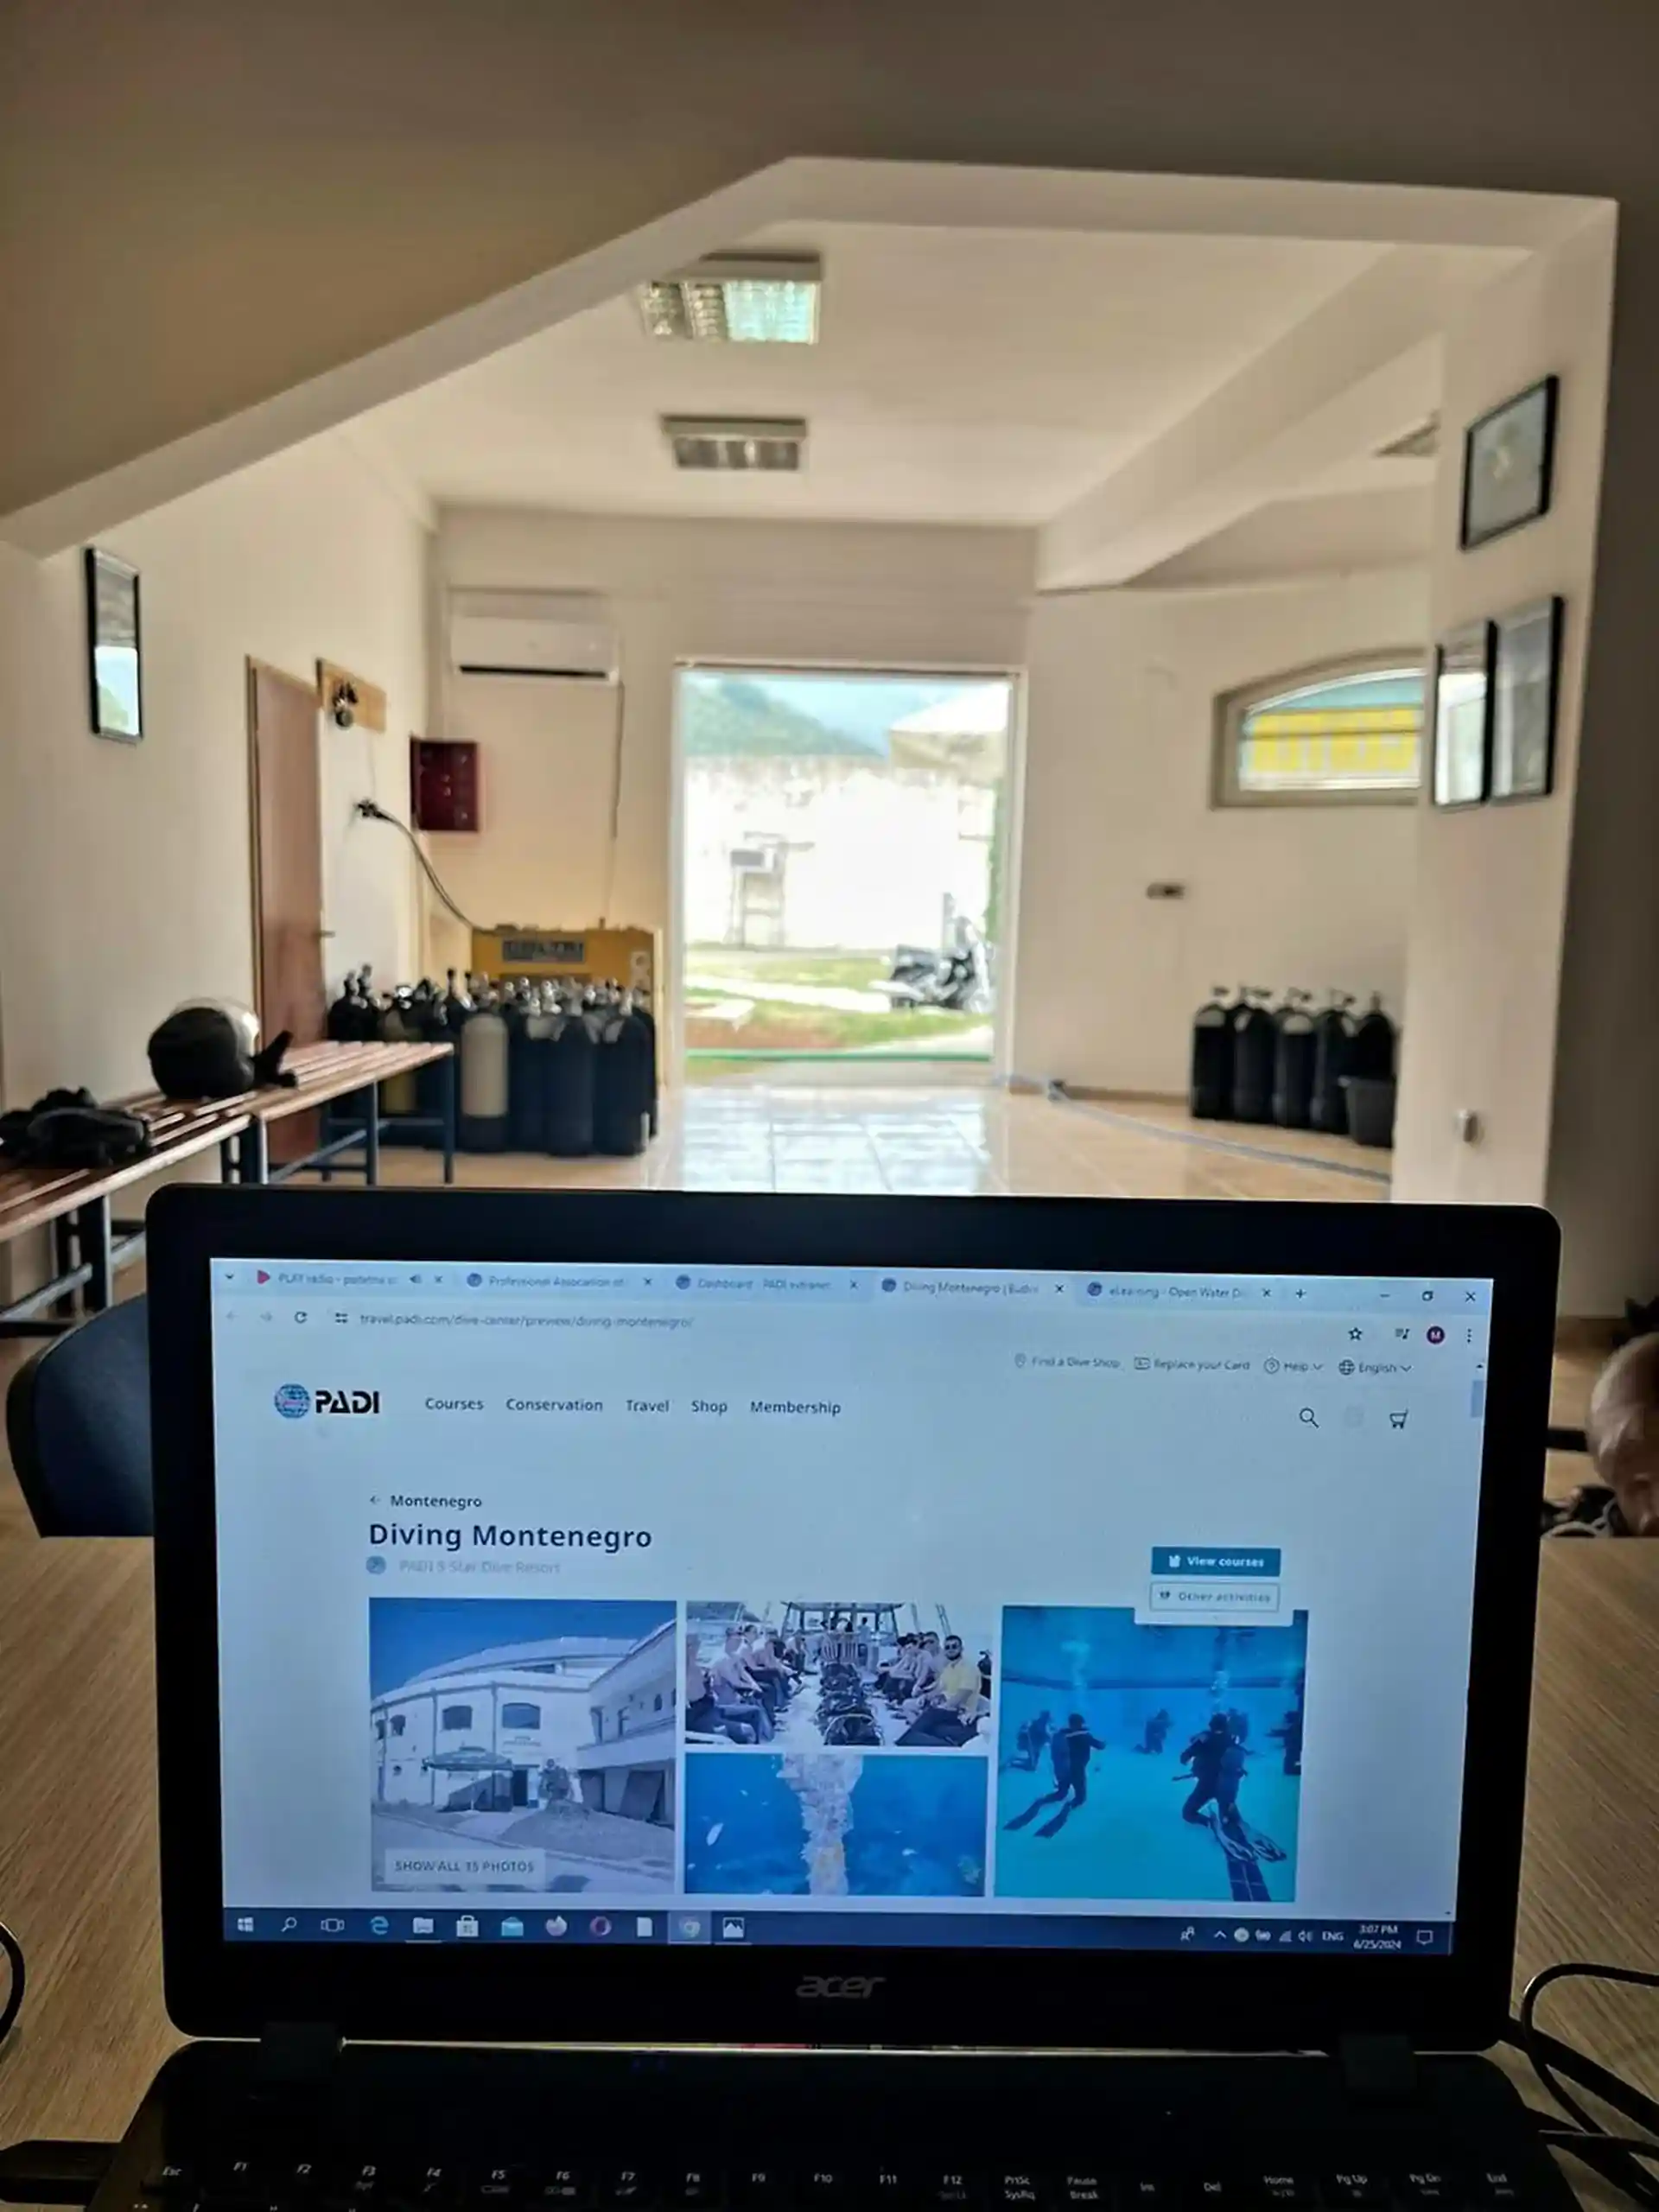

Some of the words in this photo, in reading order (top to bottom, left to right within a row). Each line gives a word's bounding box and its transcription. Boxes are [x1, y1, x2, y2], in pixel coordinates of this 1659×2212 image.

[1168, 1286, 1197, 1299] Open
[1154, 1359, 1196, 1372] Replace
[1224, 1360, 1250, 1371] Card
[1284, 1362, 1308, 1373] Help
[1358, 1363, 1397, 1376] English
[315, 1389, 380, 1414] PADI
[424, 1397, 484, 1412] Courses
[505, 1397, 603, 1413] Conservation
[626, 1398, 671, 1413] Travel
[690, 1399, 728, 1416] Shop
[750, 1400, 842, 1417] Membership
[390, 1494, 482, 1511] Montenegro
[369, 1522, 461, 1552] Diving
[473, 1524, 653, 1554] Montenegro
[516, 1561, 561, 1575] Resort
[1186, 1556, 1217, 1567] View
[1218, 1558, 1265, 1567] courses
[1178, 1592, 1213, 1602] Other
[1216, 1592, 1271, 1604] activities
[394, 1859, 434, 1872] SHOW
[435, 1859, 461, 1872] ALL
[482, 1860, 535, 1873] PHOTOS
[1321, 1930, 1344, 1942] ENG
[1358, 1924, 1380, 1935] 3:07
[1381, 1924, 1399, 1935] PM
[795, 1975, 887, 1999] acer
[296, 2163, 313, 2174] F2
[361, 2164, 378, 2177] F3
[426, 2166, 443, 2178] F4
[490, 2168, 508, 2181] F5
[556, 2170, 571, 2182] F6
[751, 2171, 767, 2183] F9
[813, 2172, 834, 2185] F10
[878, 2173, 898, 2185] F11
[943, 2174, 964, 2186] F12
[1262, 2173, 1294, 2185] Home
[1069, 2189, 1100, 2201] Break
